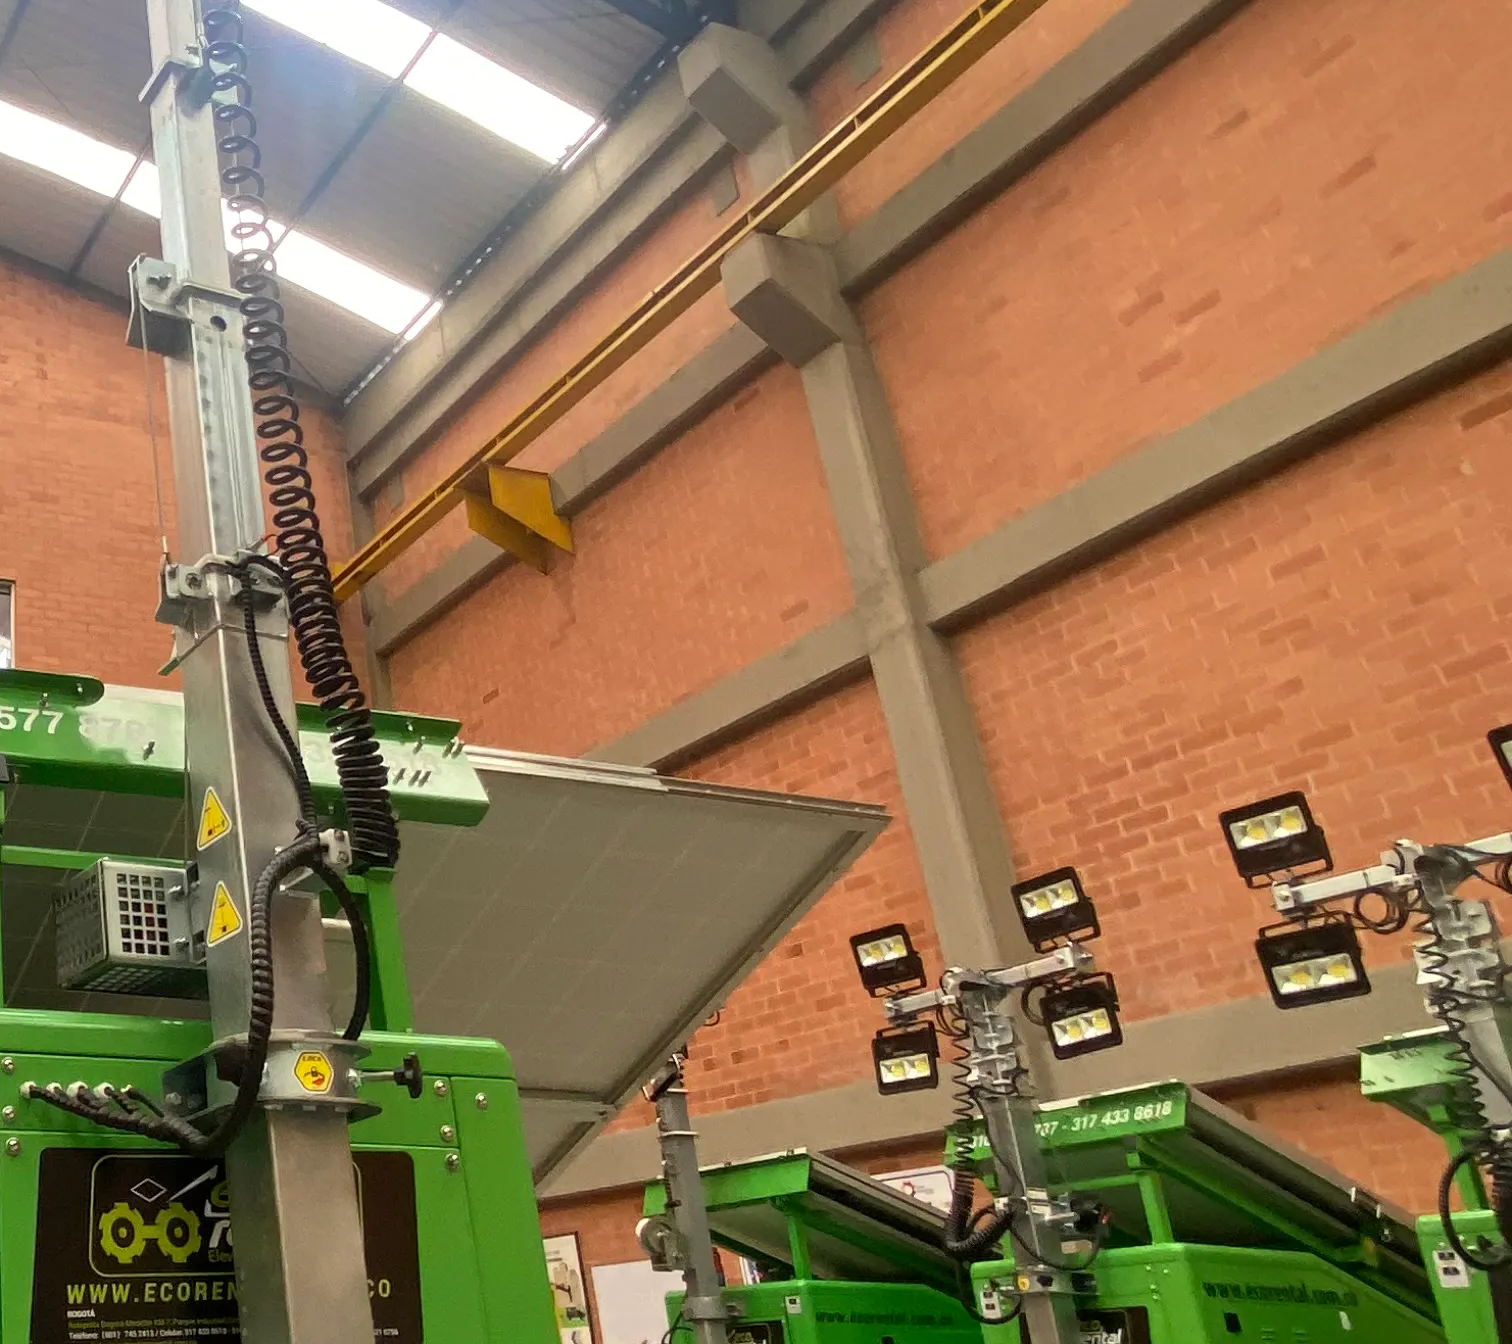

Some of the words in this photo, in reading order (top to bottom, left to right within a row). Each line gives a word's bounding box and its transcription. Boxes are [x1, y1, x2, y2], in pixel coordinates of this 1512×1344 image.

[1071, 1114, 1097, 1132] 317
[1101, 1108, 1130, 1126] 433
[1133, 1100, 1173, 1122] 8618
